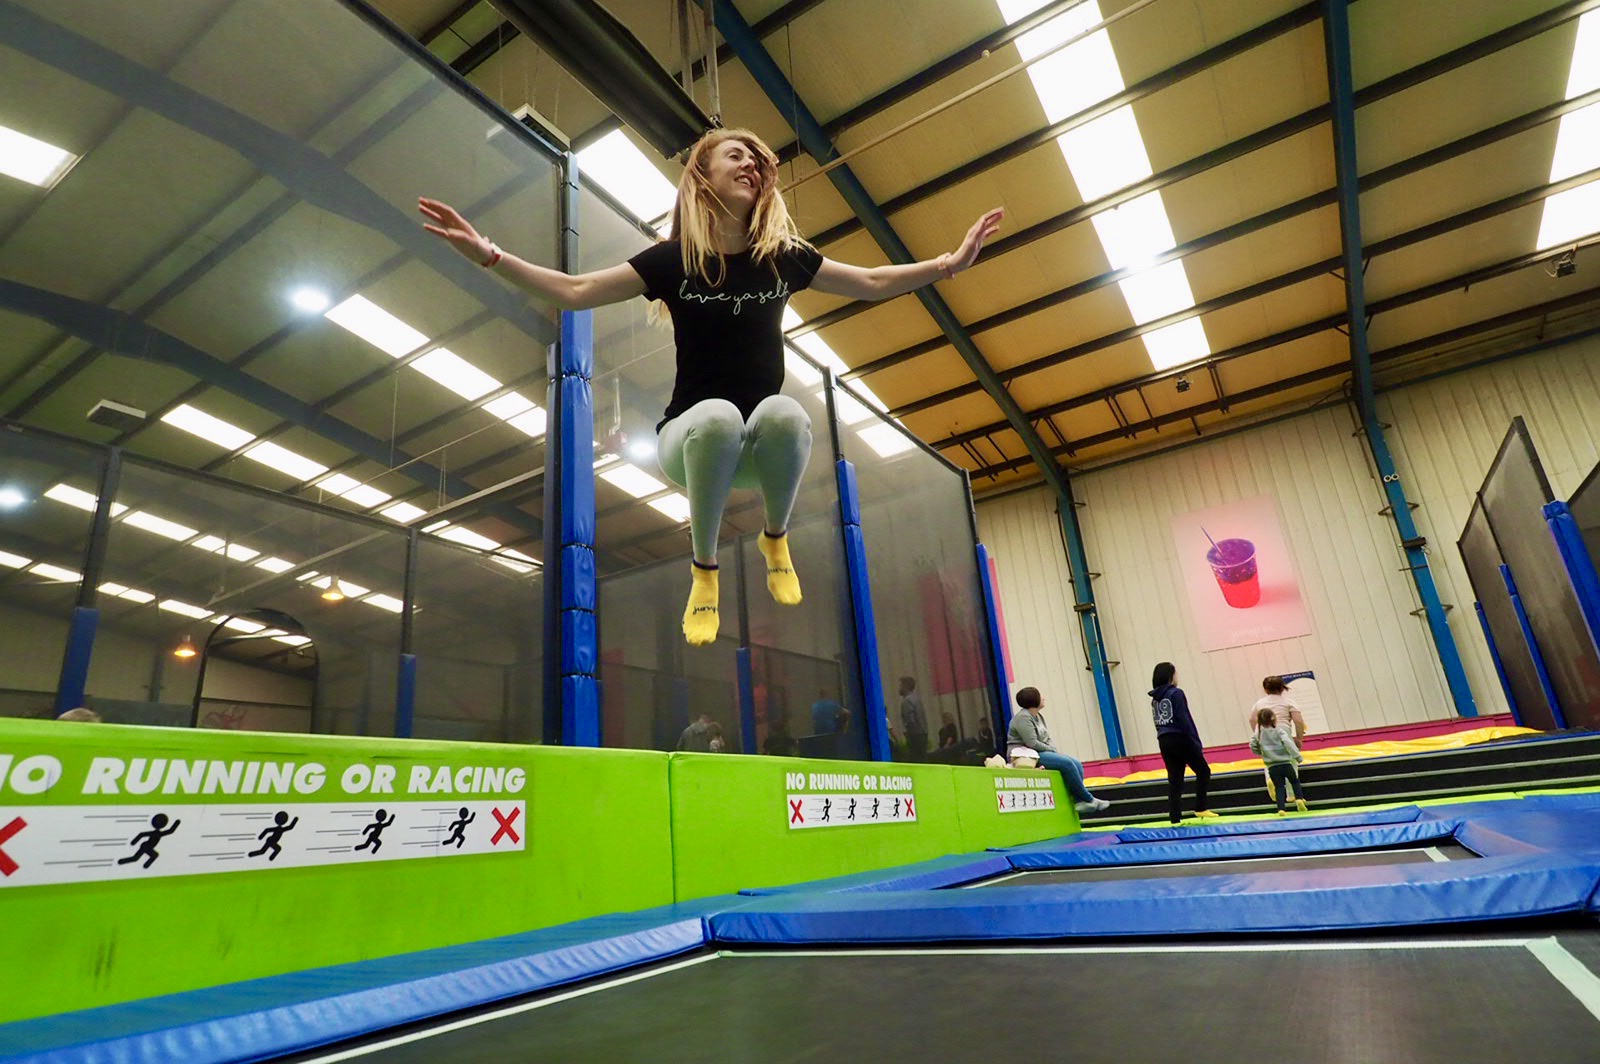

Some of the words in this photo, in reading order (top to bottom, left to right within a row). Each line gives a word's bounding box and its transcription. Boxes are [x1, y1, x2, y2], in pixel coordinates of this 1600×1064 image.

[678, 279, 731, 304] love
[0, 754, 63, 795] O
[81, 756, 327, 795] RUNNING
[341, 764, 397, 794] OR
[407, 765, 527, 794] RACING
[786, 772, 806, 791] NO
[809, 773, 861, 791] RUNNING
[863, 774, 878, 791] OR
[879, 775, 913, 791] RACING
